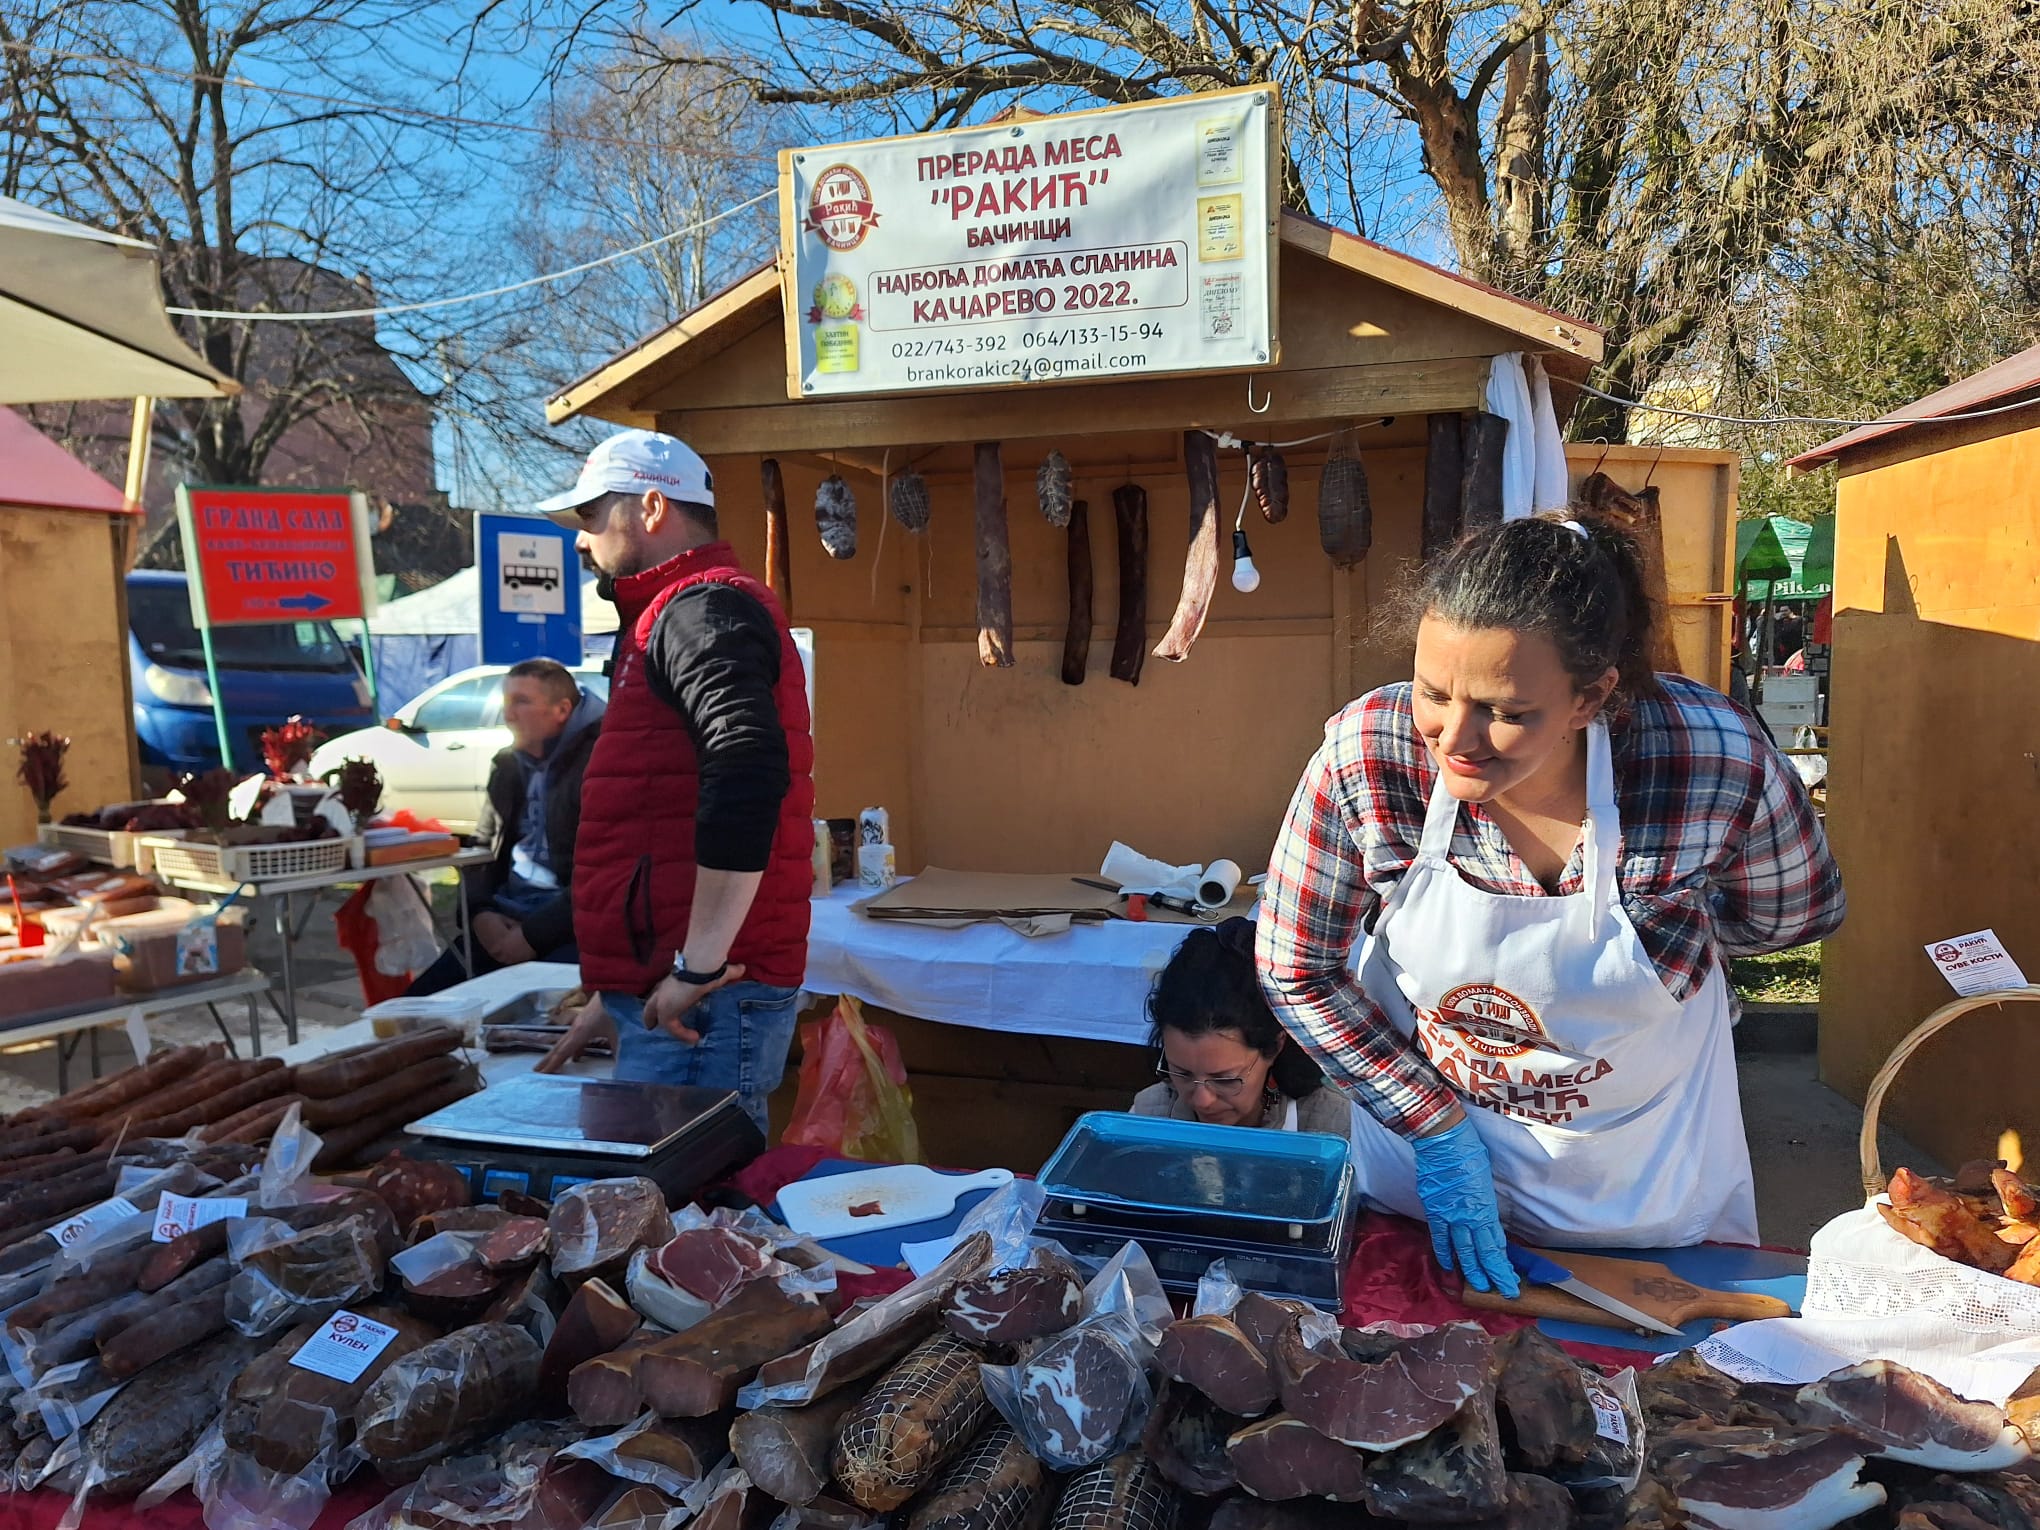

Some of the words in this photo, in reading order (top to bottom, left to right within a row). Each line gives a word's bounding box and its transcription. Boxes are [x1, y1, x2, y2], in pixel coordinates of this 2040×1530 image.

[918, 144, 1037, 181] ПРЕРАДА
[1044, 133, 1122, 166] МЕСА
[966, 217, 1071, 248] БАЧИНЦИ
[877, 267, 969, 297] НАЈБОЉА
[973, 257, 1066, 288] ДОМАЋА
[1070, 247, 1178, 276] СЛАНИНА
[913, 287, 1056, 323] КАЧАРЕВО
[1063, 280, 1139, 311] 2022.
[892, 335, 1007, 358] 022/743-392
[1022, 322, 1164, 349] 064/133-15-94
[907, 352, 1147, 382] brankorakic24@gmail.com
[204, 506, 282, 531] ГРАНД
[287, 510, 343, 531] САЛА
[1958, 938, 1988, 949] РАКИЋ
[1945, 960, 1969, 971] СУВЕ
[1970, 952, 2004, 964] КОСТИ
[1456, 987, 1496, 999] ДОМАЋИ
[1499, 992, 1539, 1033] ПРОИЗВОДИ
[1465, 1034, 1522, 1056] БАЧИНЦИ
[1522, 1058, 1614, 1089] МЕСА
[329, 1332, 369, 1351] КУЛЕН
